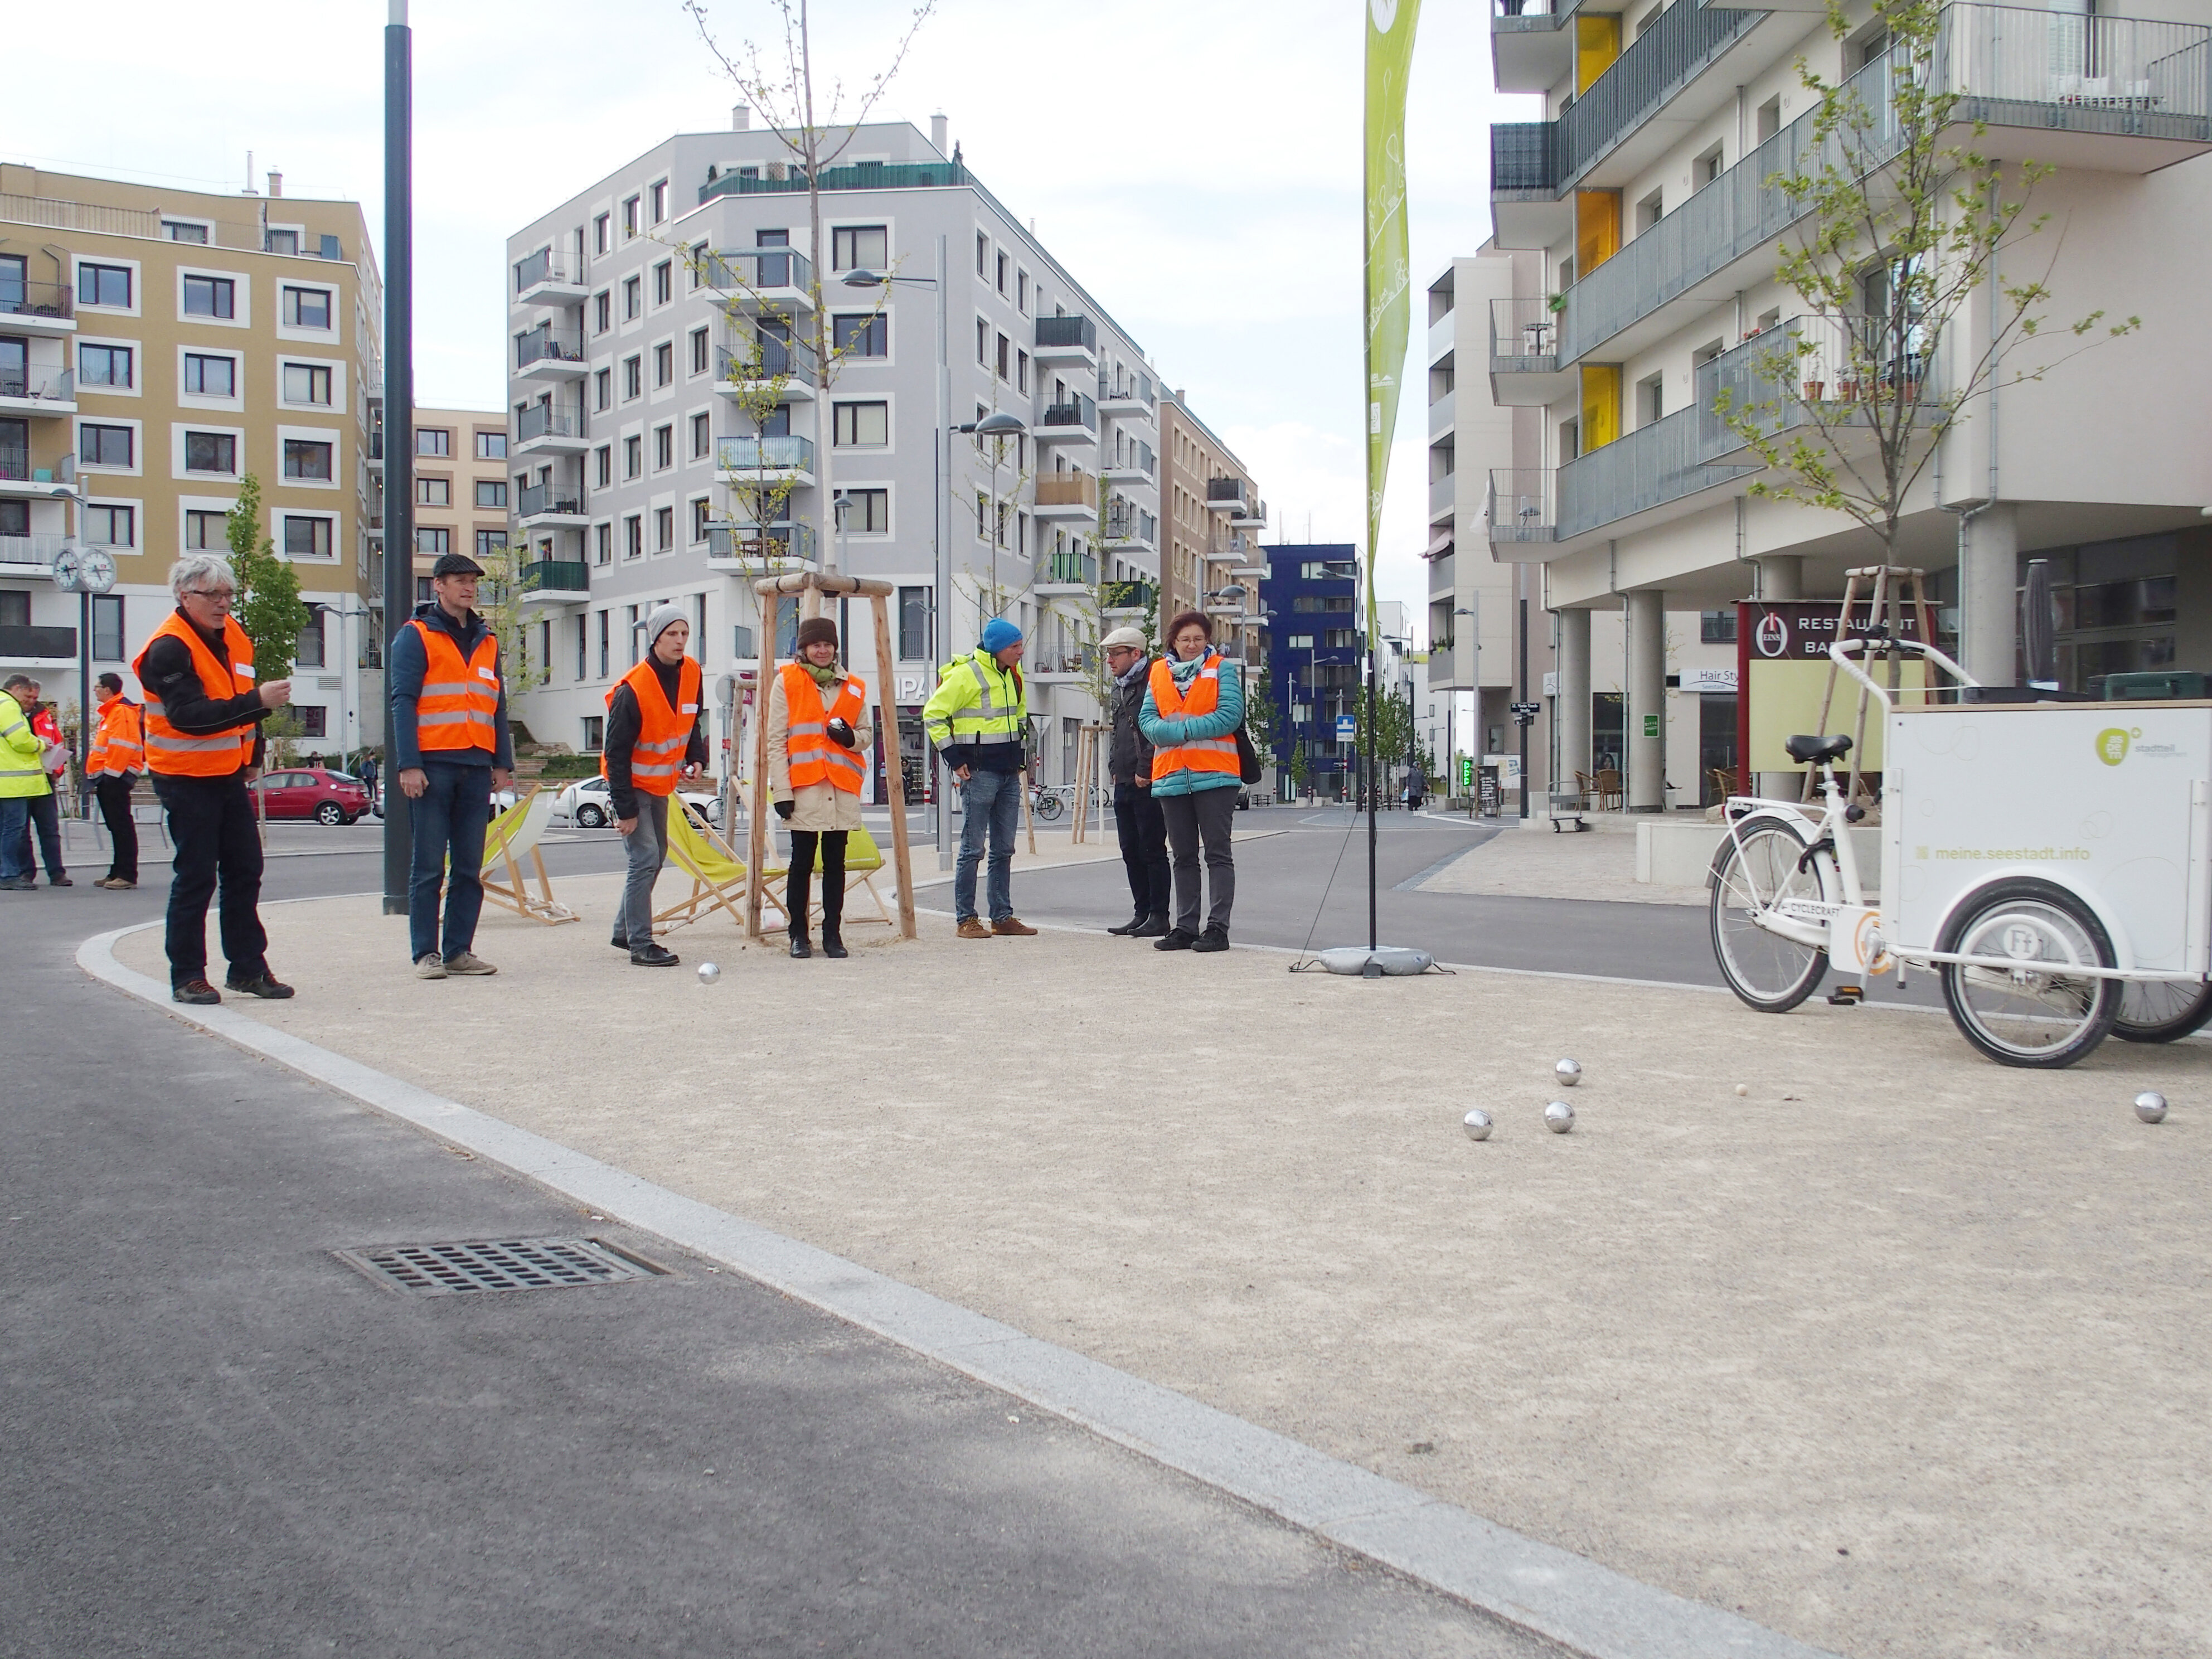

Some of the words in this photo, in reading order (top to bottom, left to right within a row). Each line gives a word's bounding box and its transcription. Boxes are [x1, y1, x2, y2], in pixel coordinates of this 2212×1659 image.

[1700, 671, 1721, 680] Hair
[2135, 744, 2175, 753] stadtteil
[1936, 846, 2090, 860] meine.seestadt.info
[1791, 903, 1840, 918] CYCLECRAFT
[2010, 929, 2032, 953] Ff
